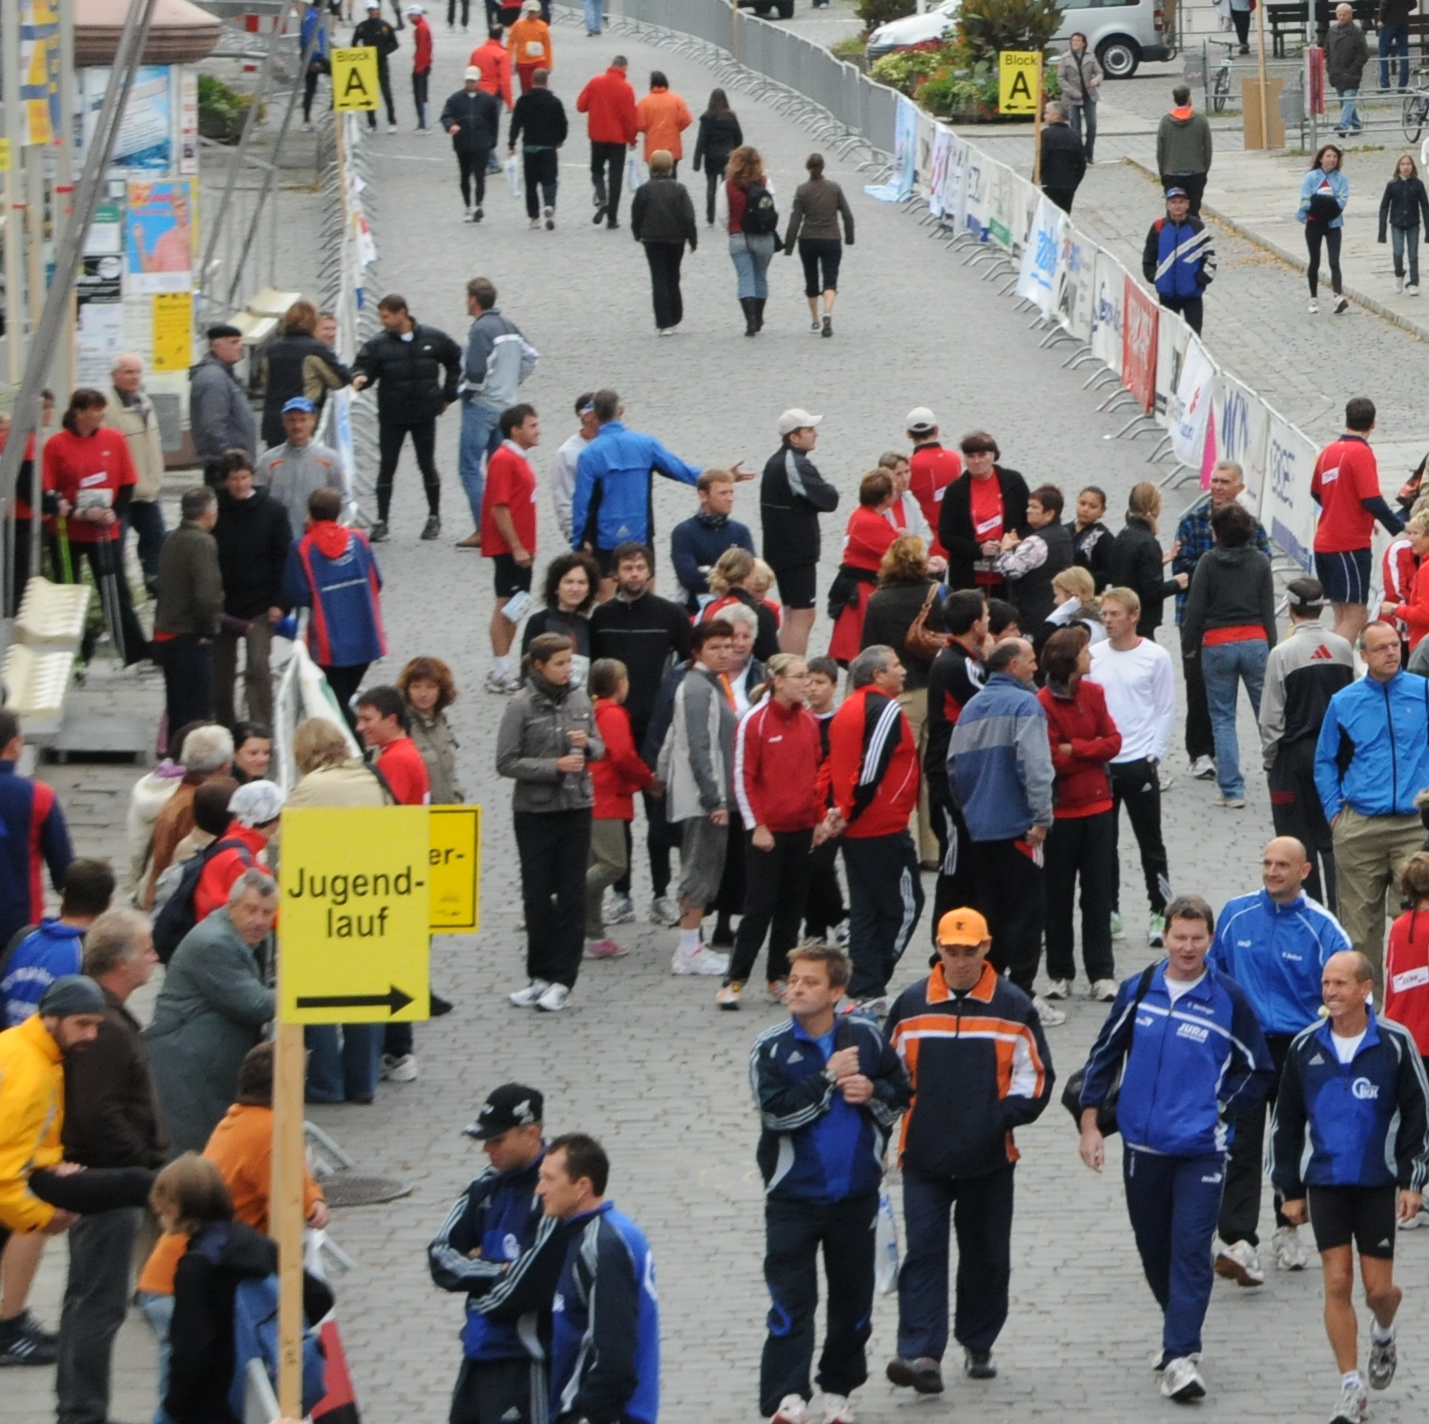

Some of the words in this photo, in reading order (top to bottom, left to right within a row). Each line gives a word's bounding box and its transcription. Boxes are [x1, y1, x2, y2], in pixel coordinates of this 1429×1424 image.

[336, 49, 370, 63] Block
[1004, 54, 1038, 67] Block
[344, 67, 368, 96] A
[1008, 71, 1033, 100] A
[287, 865, 425, 906] Jugend-
[325, 905, 391, 939] lauf
